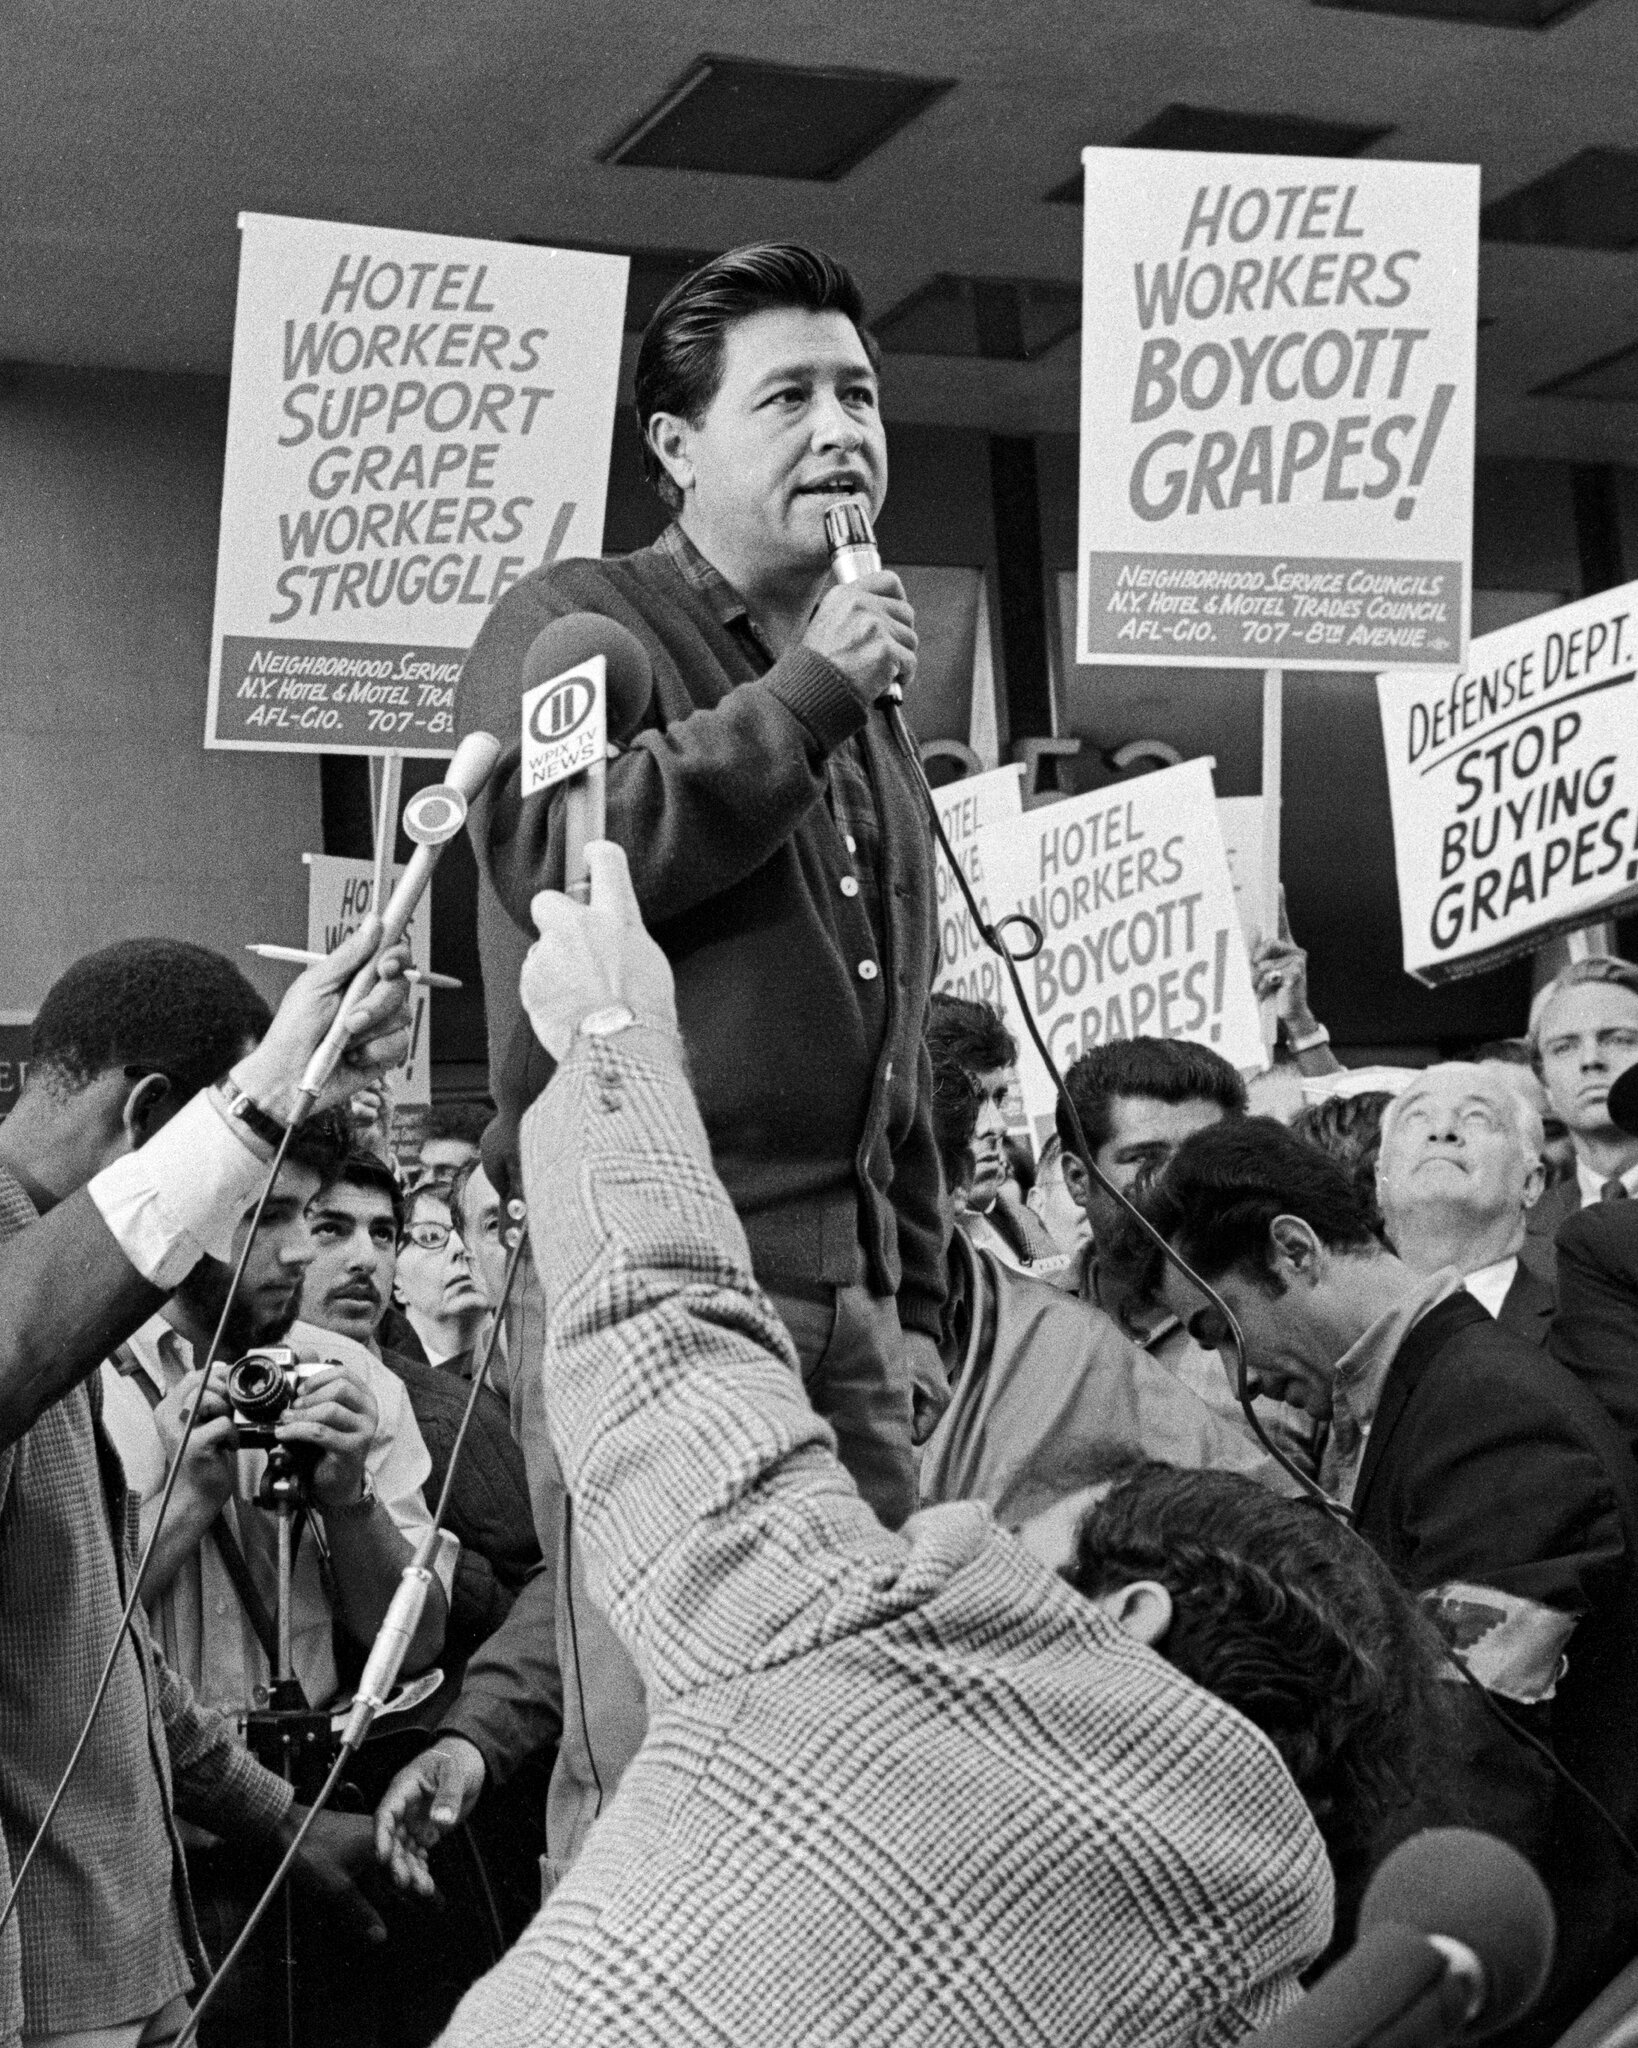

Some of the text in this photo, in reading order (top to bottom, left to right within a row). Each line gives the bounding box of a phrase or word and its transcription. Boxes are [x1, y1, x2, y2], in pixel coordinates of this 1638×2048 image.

[1180, 184, 1364, 252] HOTEL
[320, 254, 494, 315] HOTEL
[1133, 249, 1421, 330] WORKERS
[282, 319, 549, 381] WORKERS
[1130, 328, 1431, 423] BOYCOTT
[277, 380, 555, 447] SUPPORT
[307, 443, 501, 500] GRAPE
[1129, 383, 1456, 522] GRAPES!
[279, 496, 534, 561] WORKERS
[1106, 591, 1448, 622] N.Y. HOTEL & MOTEL TRADES COUNCIL
[1116, 562, 1444, 597] NEIGHBORHOOD SERVICE COUNCILS
[248, 650, 393, 678] NEIGHBORHOOD
[1117, 616, 1218, 642] AFL-CIO.
[1346, 622, 1427, 649] AVENUE
[1542, 613, 1632, 690] DEPT.
[236, 676, 278, 699] N.Y.
[277, 677, 328, 701] HOTEL
[332, 683, 348, 701] &
[346, 680, 409, 705] MOTEL
[245, 704, 343, 729] AFL-CIO.
[529, 727, 597, 770] WPIX TV
[532, 743, 594, 786] NEWS
[1456, 711, 1582, 813] STOP
[1040, 800, 1144, 882] HOTEL
[1441, 755, 1617, 880] BUYING
[1017, 835, 1185, 948] WORKERS
[1034, 892, 1203, 1016] BOYCOTT
